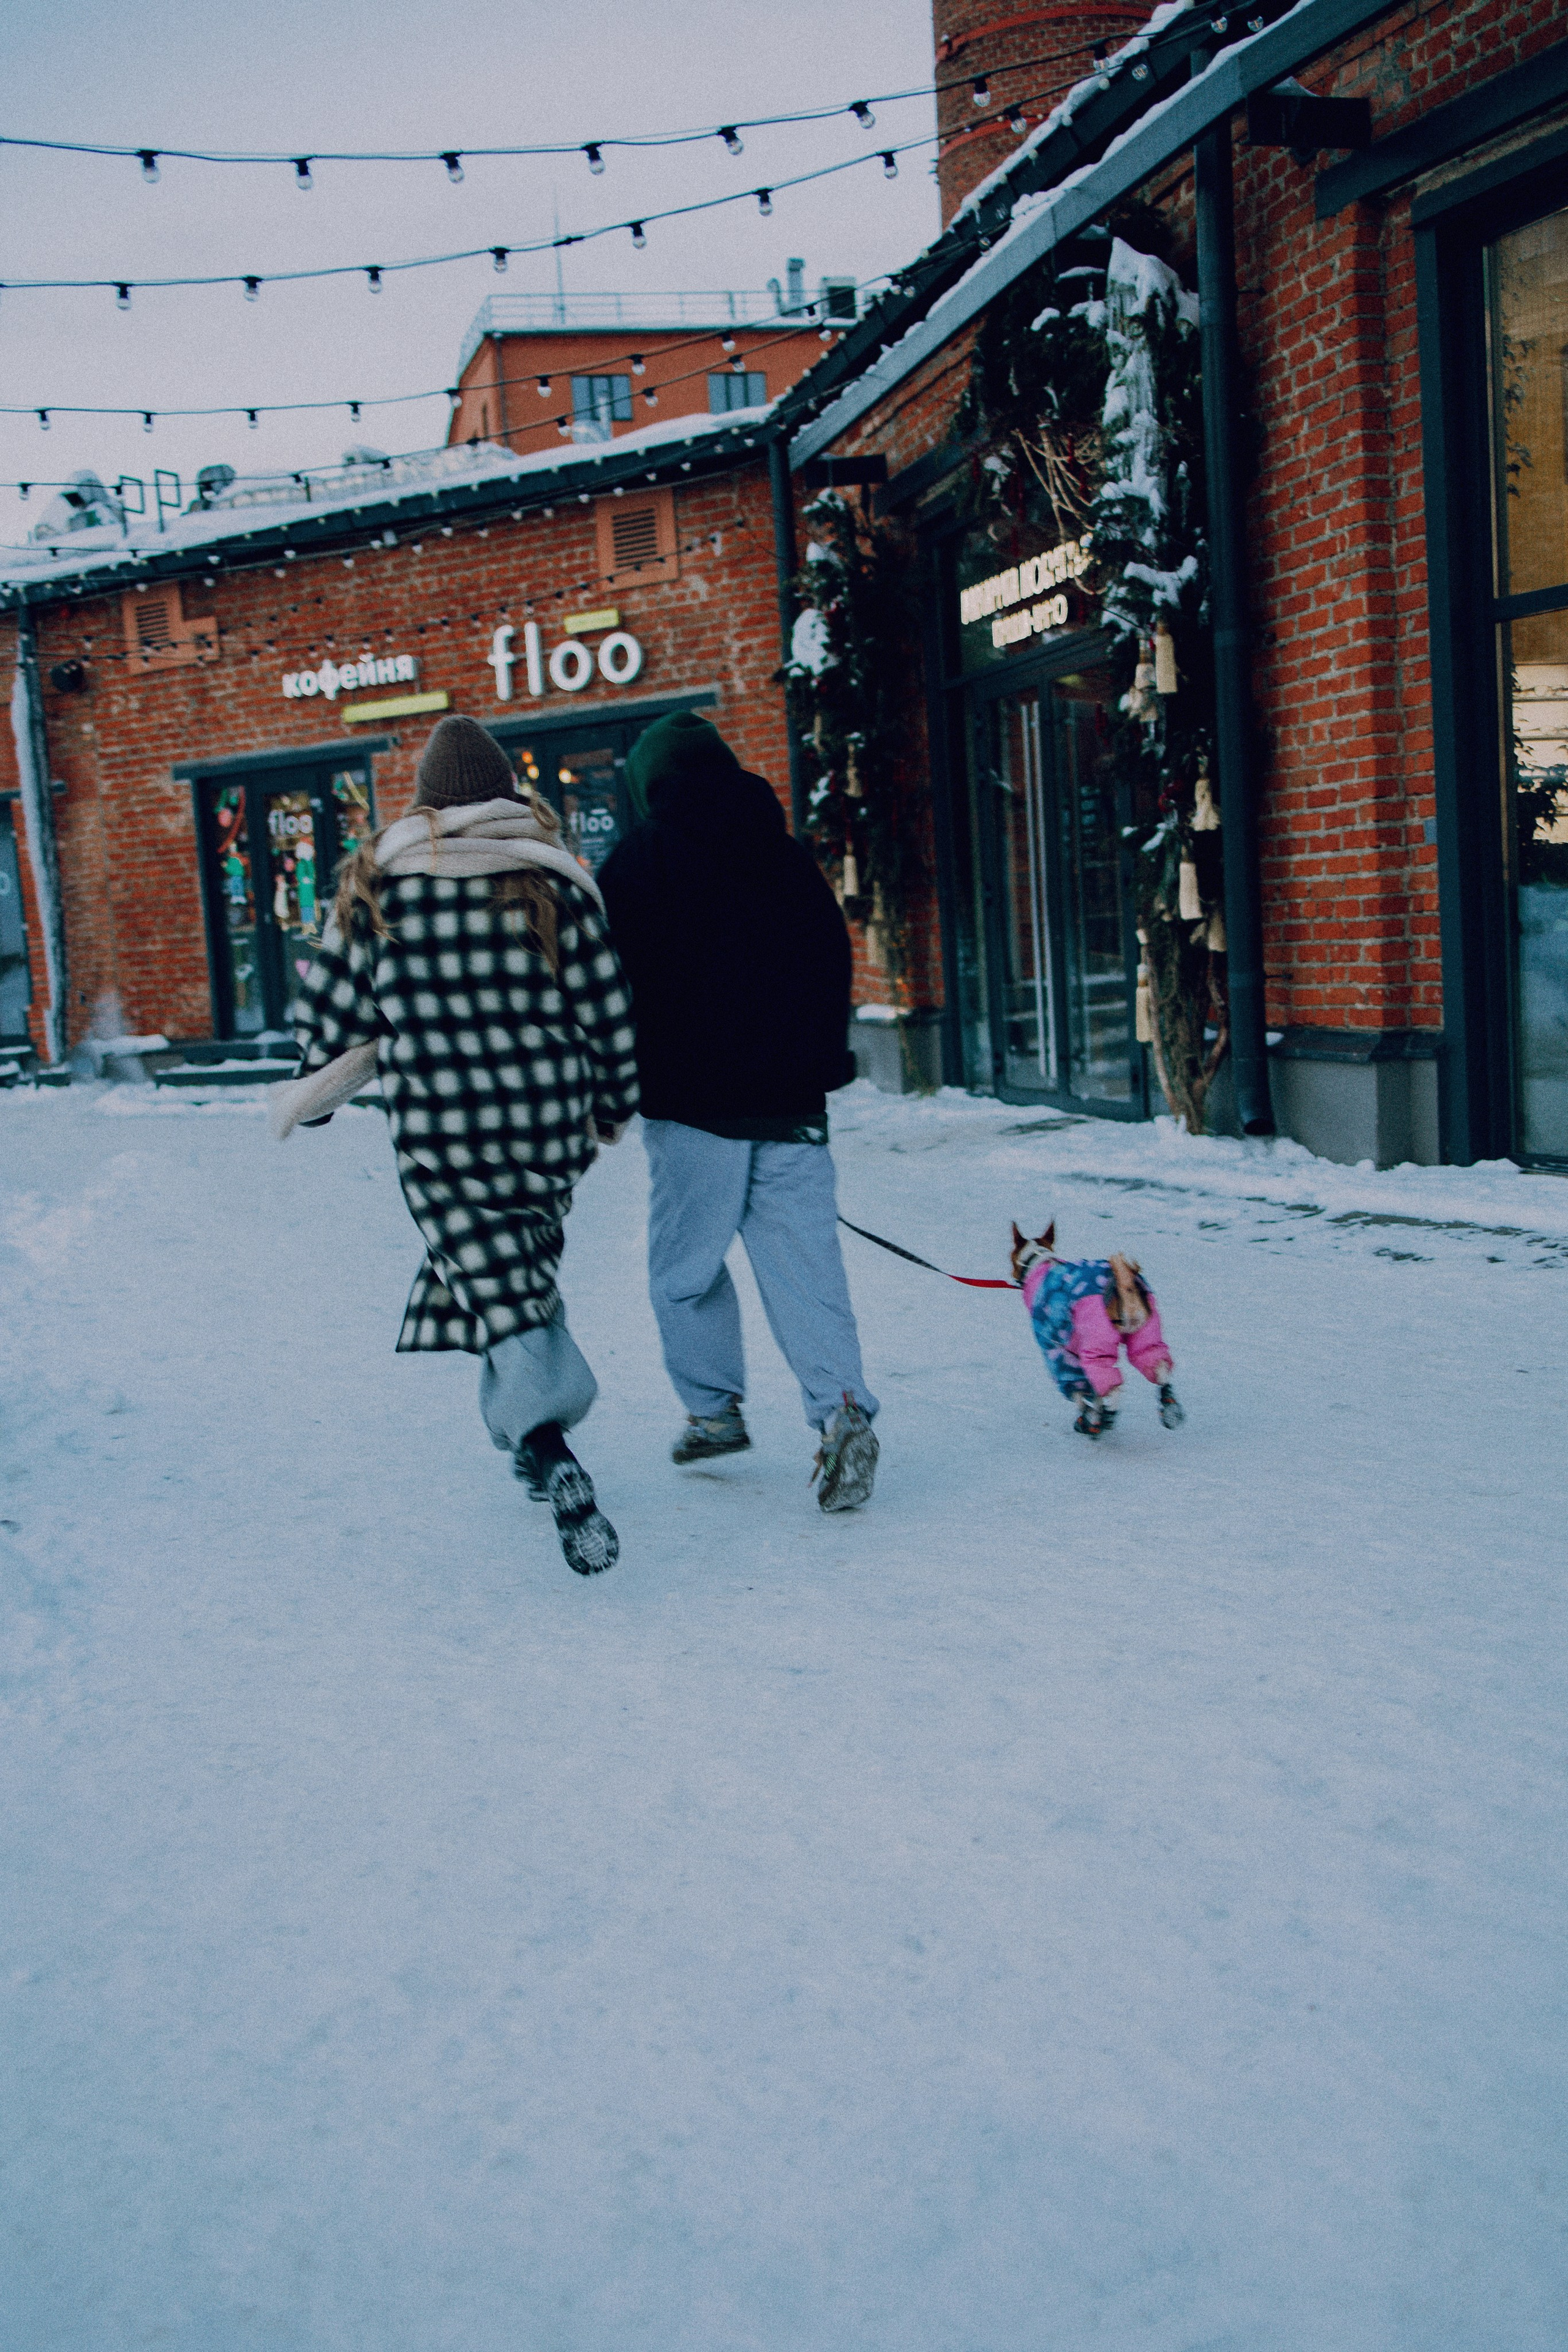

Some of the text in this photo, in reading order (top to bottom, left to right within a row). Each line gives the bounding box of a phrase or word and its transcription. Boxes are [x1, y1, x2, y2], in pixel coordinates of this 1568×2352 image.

[282, 653, 417, 701] кофейня
[488, 622, 642, 701] floo
[268, 809, 314, 837] floo
